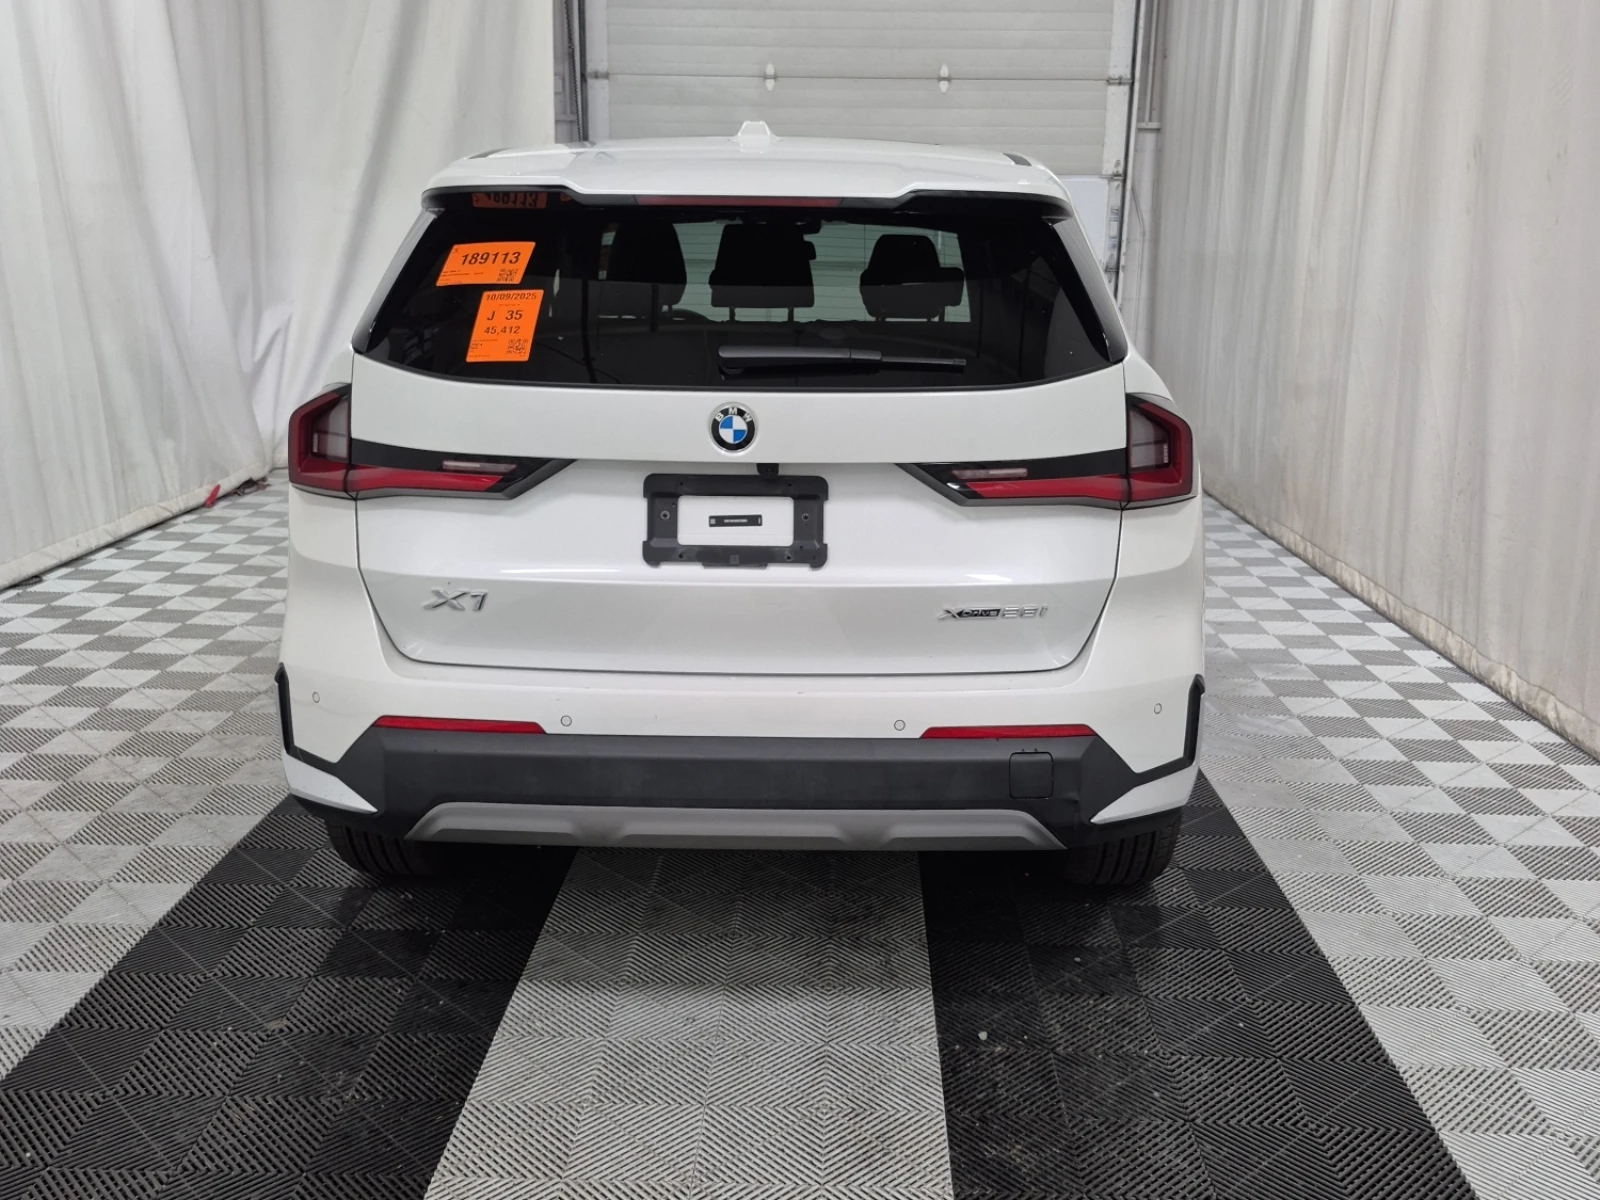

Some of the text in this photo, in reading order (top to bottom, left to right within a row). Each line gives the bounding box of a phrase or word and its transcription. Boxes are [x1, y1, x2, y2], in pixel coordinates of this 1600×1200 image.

[461, 252, 521, 266] 189113
[486, 292, 537, 301] 10/09/2025
[487, 310, 523, 321] J 35
[715, 406, 752, 423] BMW
[423, 588, 488, 611] X1
